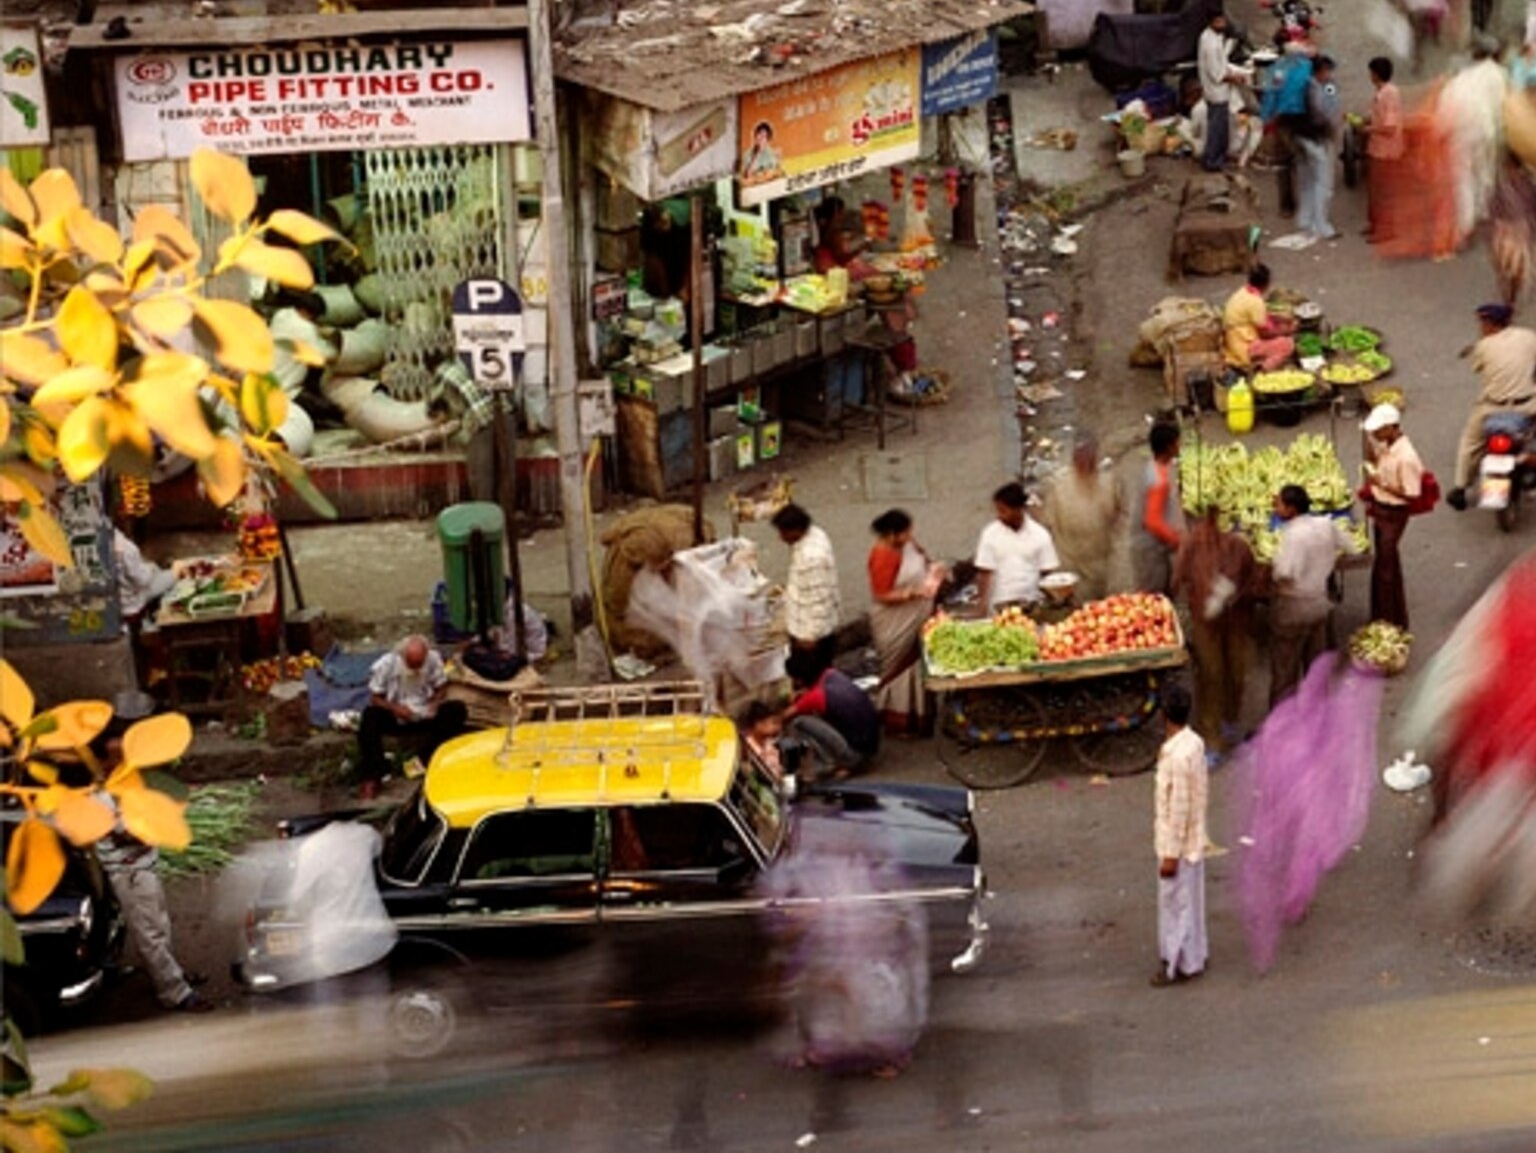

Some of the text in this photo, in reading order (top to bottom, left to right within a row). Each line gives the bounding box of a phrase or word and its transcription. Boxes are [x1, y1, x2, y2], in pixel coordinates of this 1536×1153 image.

[188, 44, 453, 79] CHOUDHARY
[188, 79, 266, 104] PIPE
[278, 72, 420, 101] FITTING
[430, 70, 495, 93] CO.
[468, 280, 503, 310] P
[481, 348, 506, 380] 5
